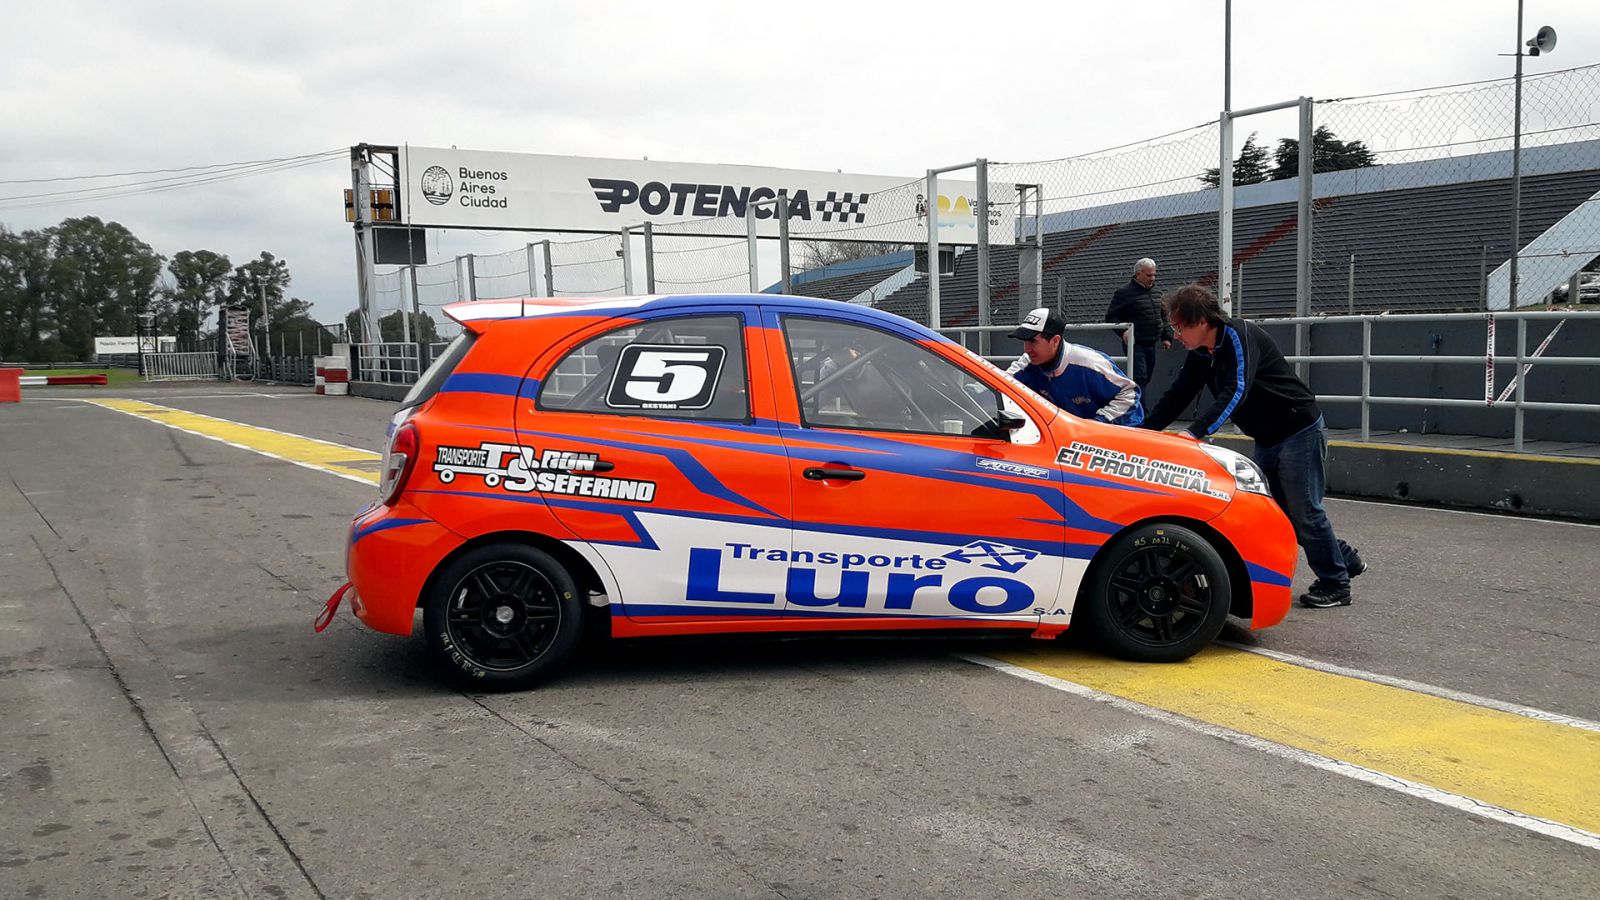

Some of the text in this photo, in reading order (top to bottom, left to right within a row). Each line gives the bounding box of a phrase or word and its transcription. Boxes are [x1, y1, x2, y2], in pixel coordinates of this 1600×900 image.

[459, 167, 508, 181] Buenos
[459, 181, 496, 194] Aires
[460, 195, 508, 208] Ciudad
[587, 178, 812, 221] POTENCIA
[625, 351, 710, 402] 5
[437, 446, 487, 467] TRANSPORTE
[1056, 447, 1082, 467] EL
[1088, 456, 1212, 495] PROVINCIAL
[1071, 442, 1205, 478] EMPRESA DE OMNIBUS
[537, 472, 656, 502] SEFERINO
[725, 542, 947, 570] Transporte
[685, 547, 1036, 614] Luro
